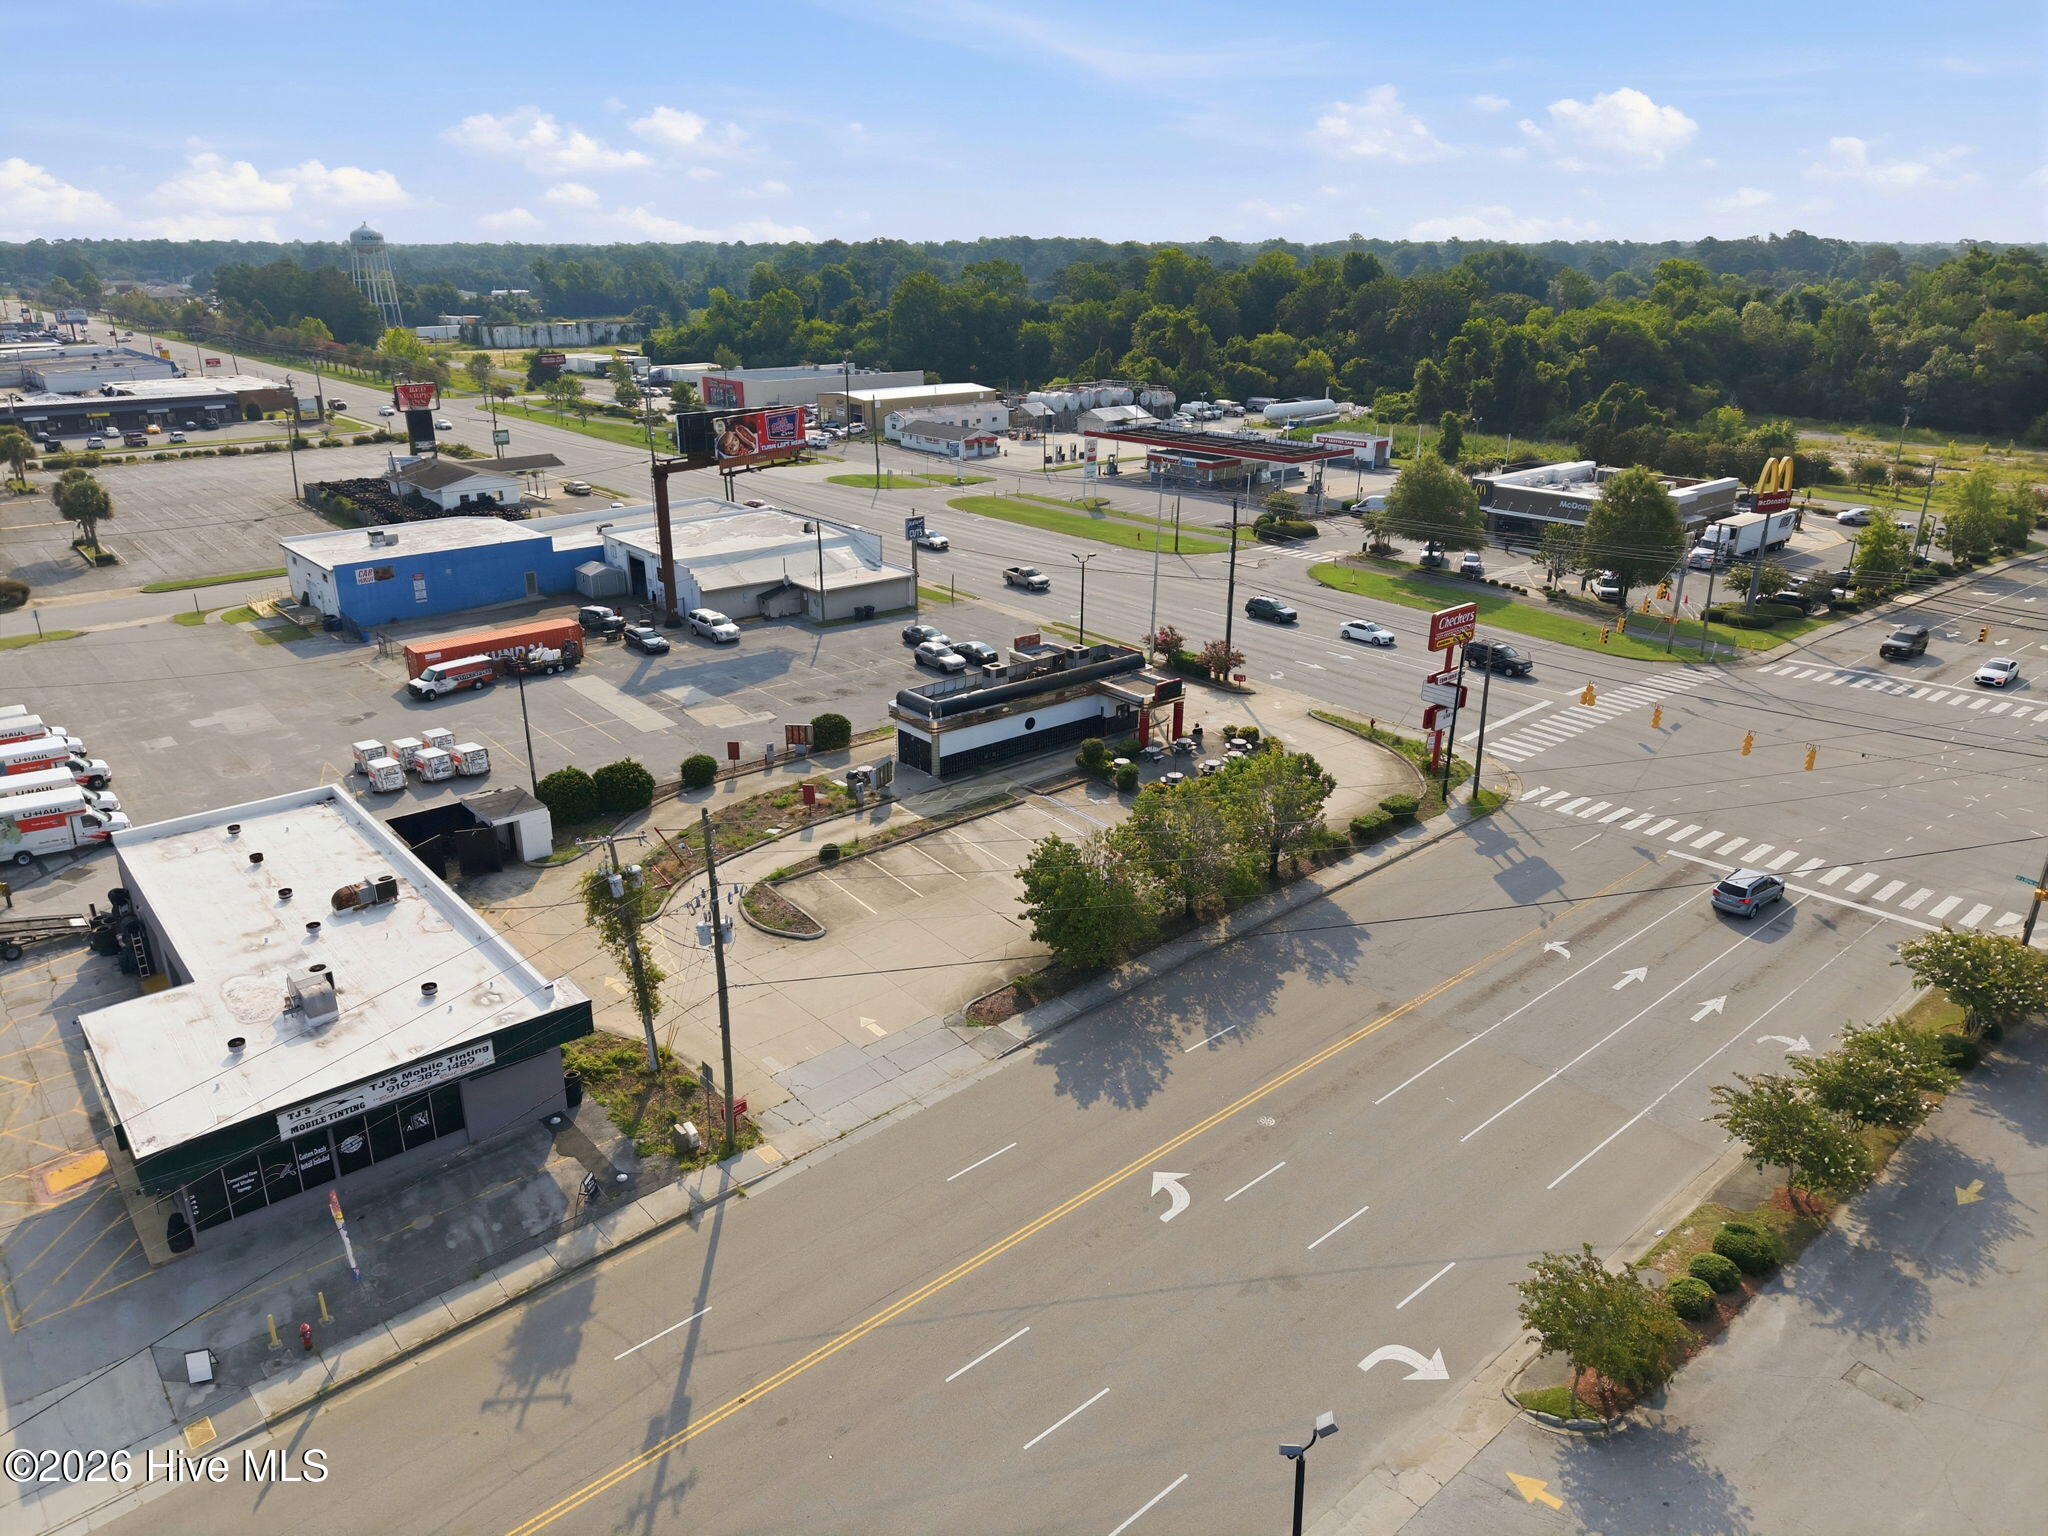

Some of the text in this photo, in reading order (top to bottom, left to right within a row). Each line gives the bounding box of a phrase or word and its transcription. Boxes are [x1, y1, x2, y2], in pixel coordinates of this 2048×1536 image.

[358, 568, 373, 578] CAR
[1439, 611, 1475, 630] Checkers
[13, 753, 50, 763] U-HAUL
[15, 785, 55, 796] U-HAUL
[22, 807, 64, 818] U-HAUL
[369, 1045, 489, 1091] TJ'S Mobile Tinting
[386, 1056, 476, 1093] 910-382-1489
[287, 1107, 312, 1120] TJ'S
[290, 1101, 366, 1135] MOBILE TINTING
